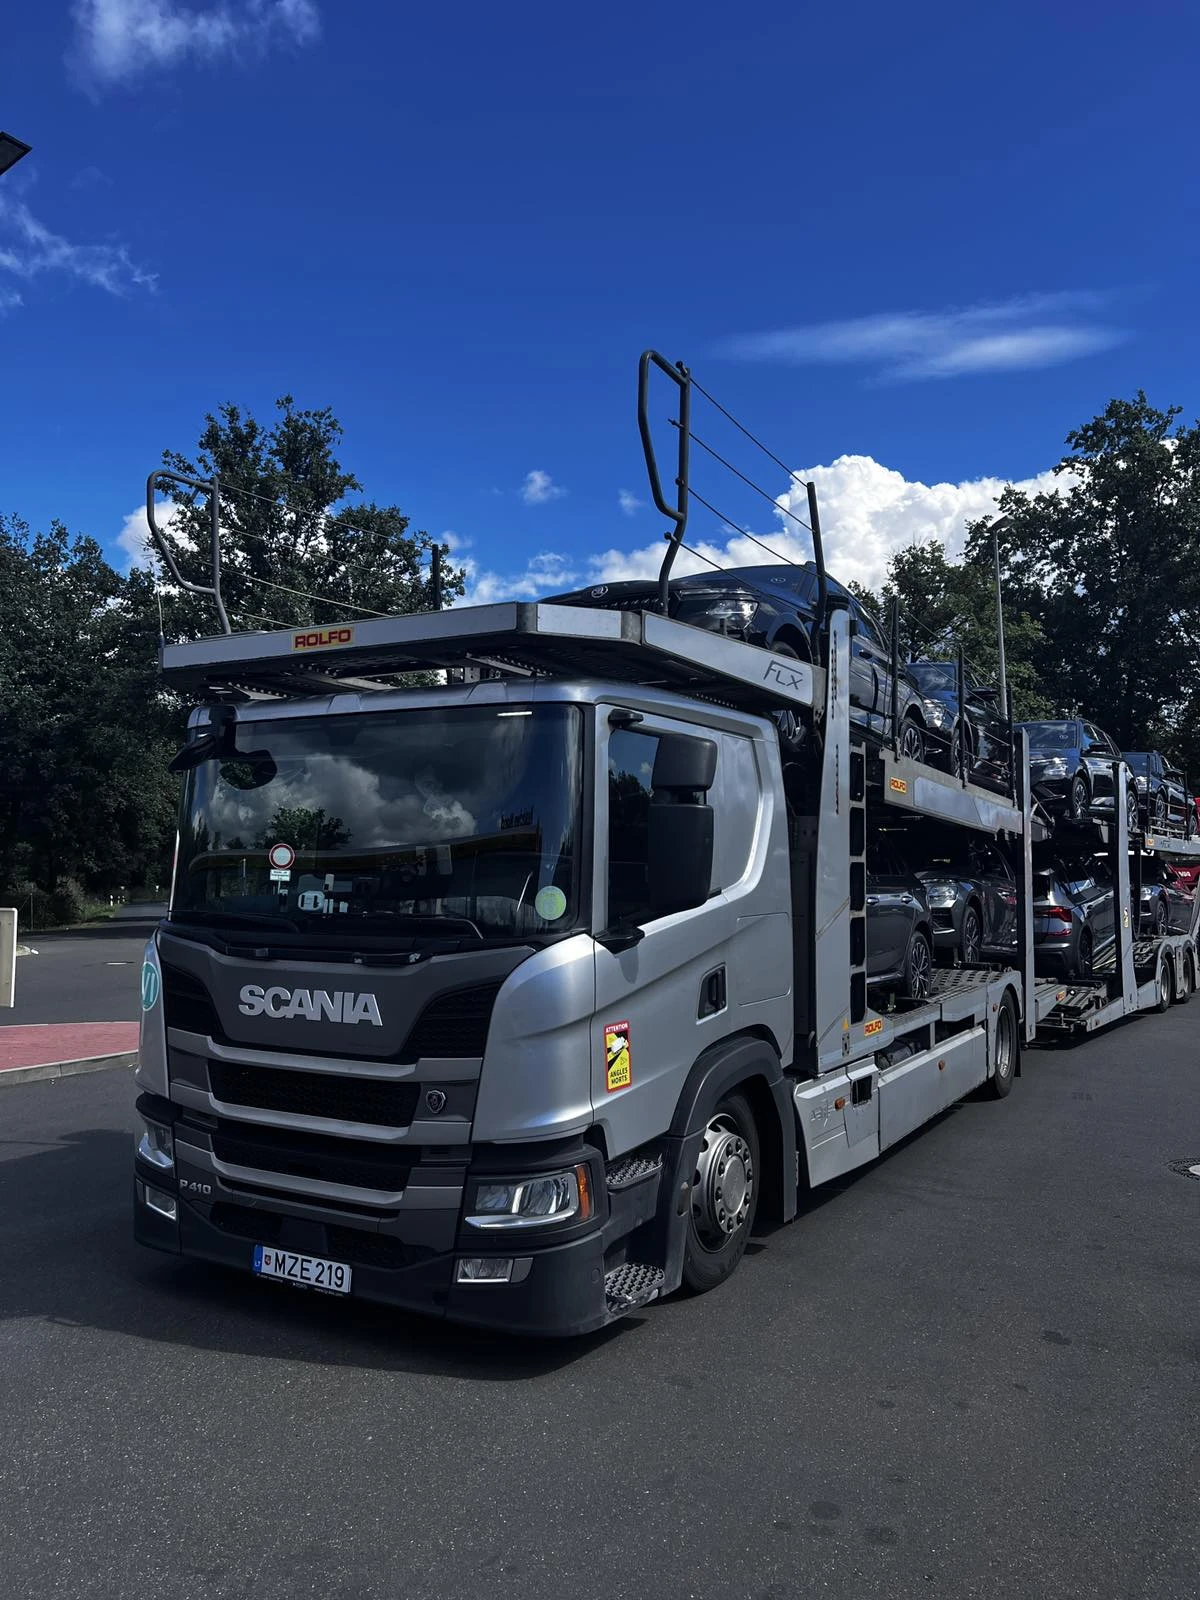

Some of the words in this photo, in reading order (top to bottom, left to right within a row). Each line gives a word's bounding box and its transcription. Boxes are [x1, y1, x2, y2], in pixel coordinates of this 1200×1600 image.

[295, 629, 351, 649] ROLFO
[763, 660, 804, 691] FLX
[238, 984, 383, 1027] SCANIA
[605, 1022, 629, 1033] ATTENTION
[864, 1020, 882, 1034] ROLFO
[610, 1067, 628, 1078] ANGLES
[611, 1074, 628, 1085] MORTS
